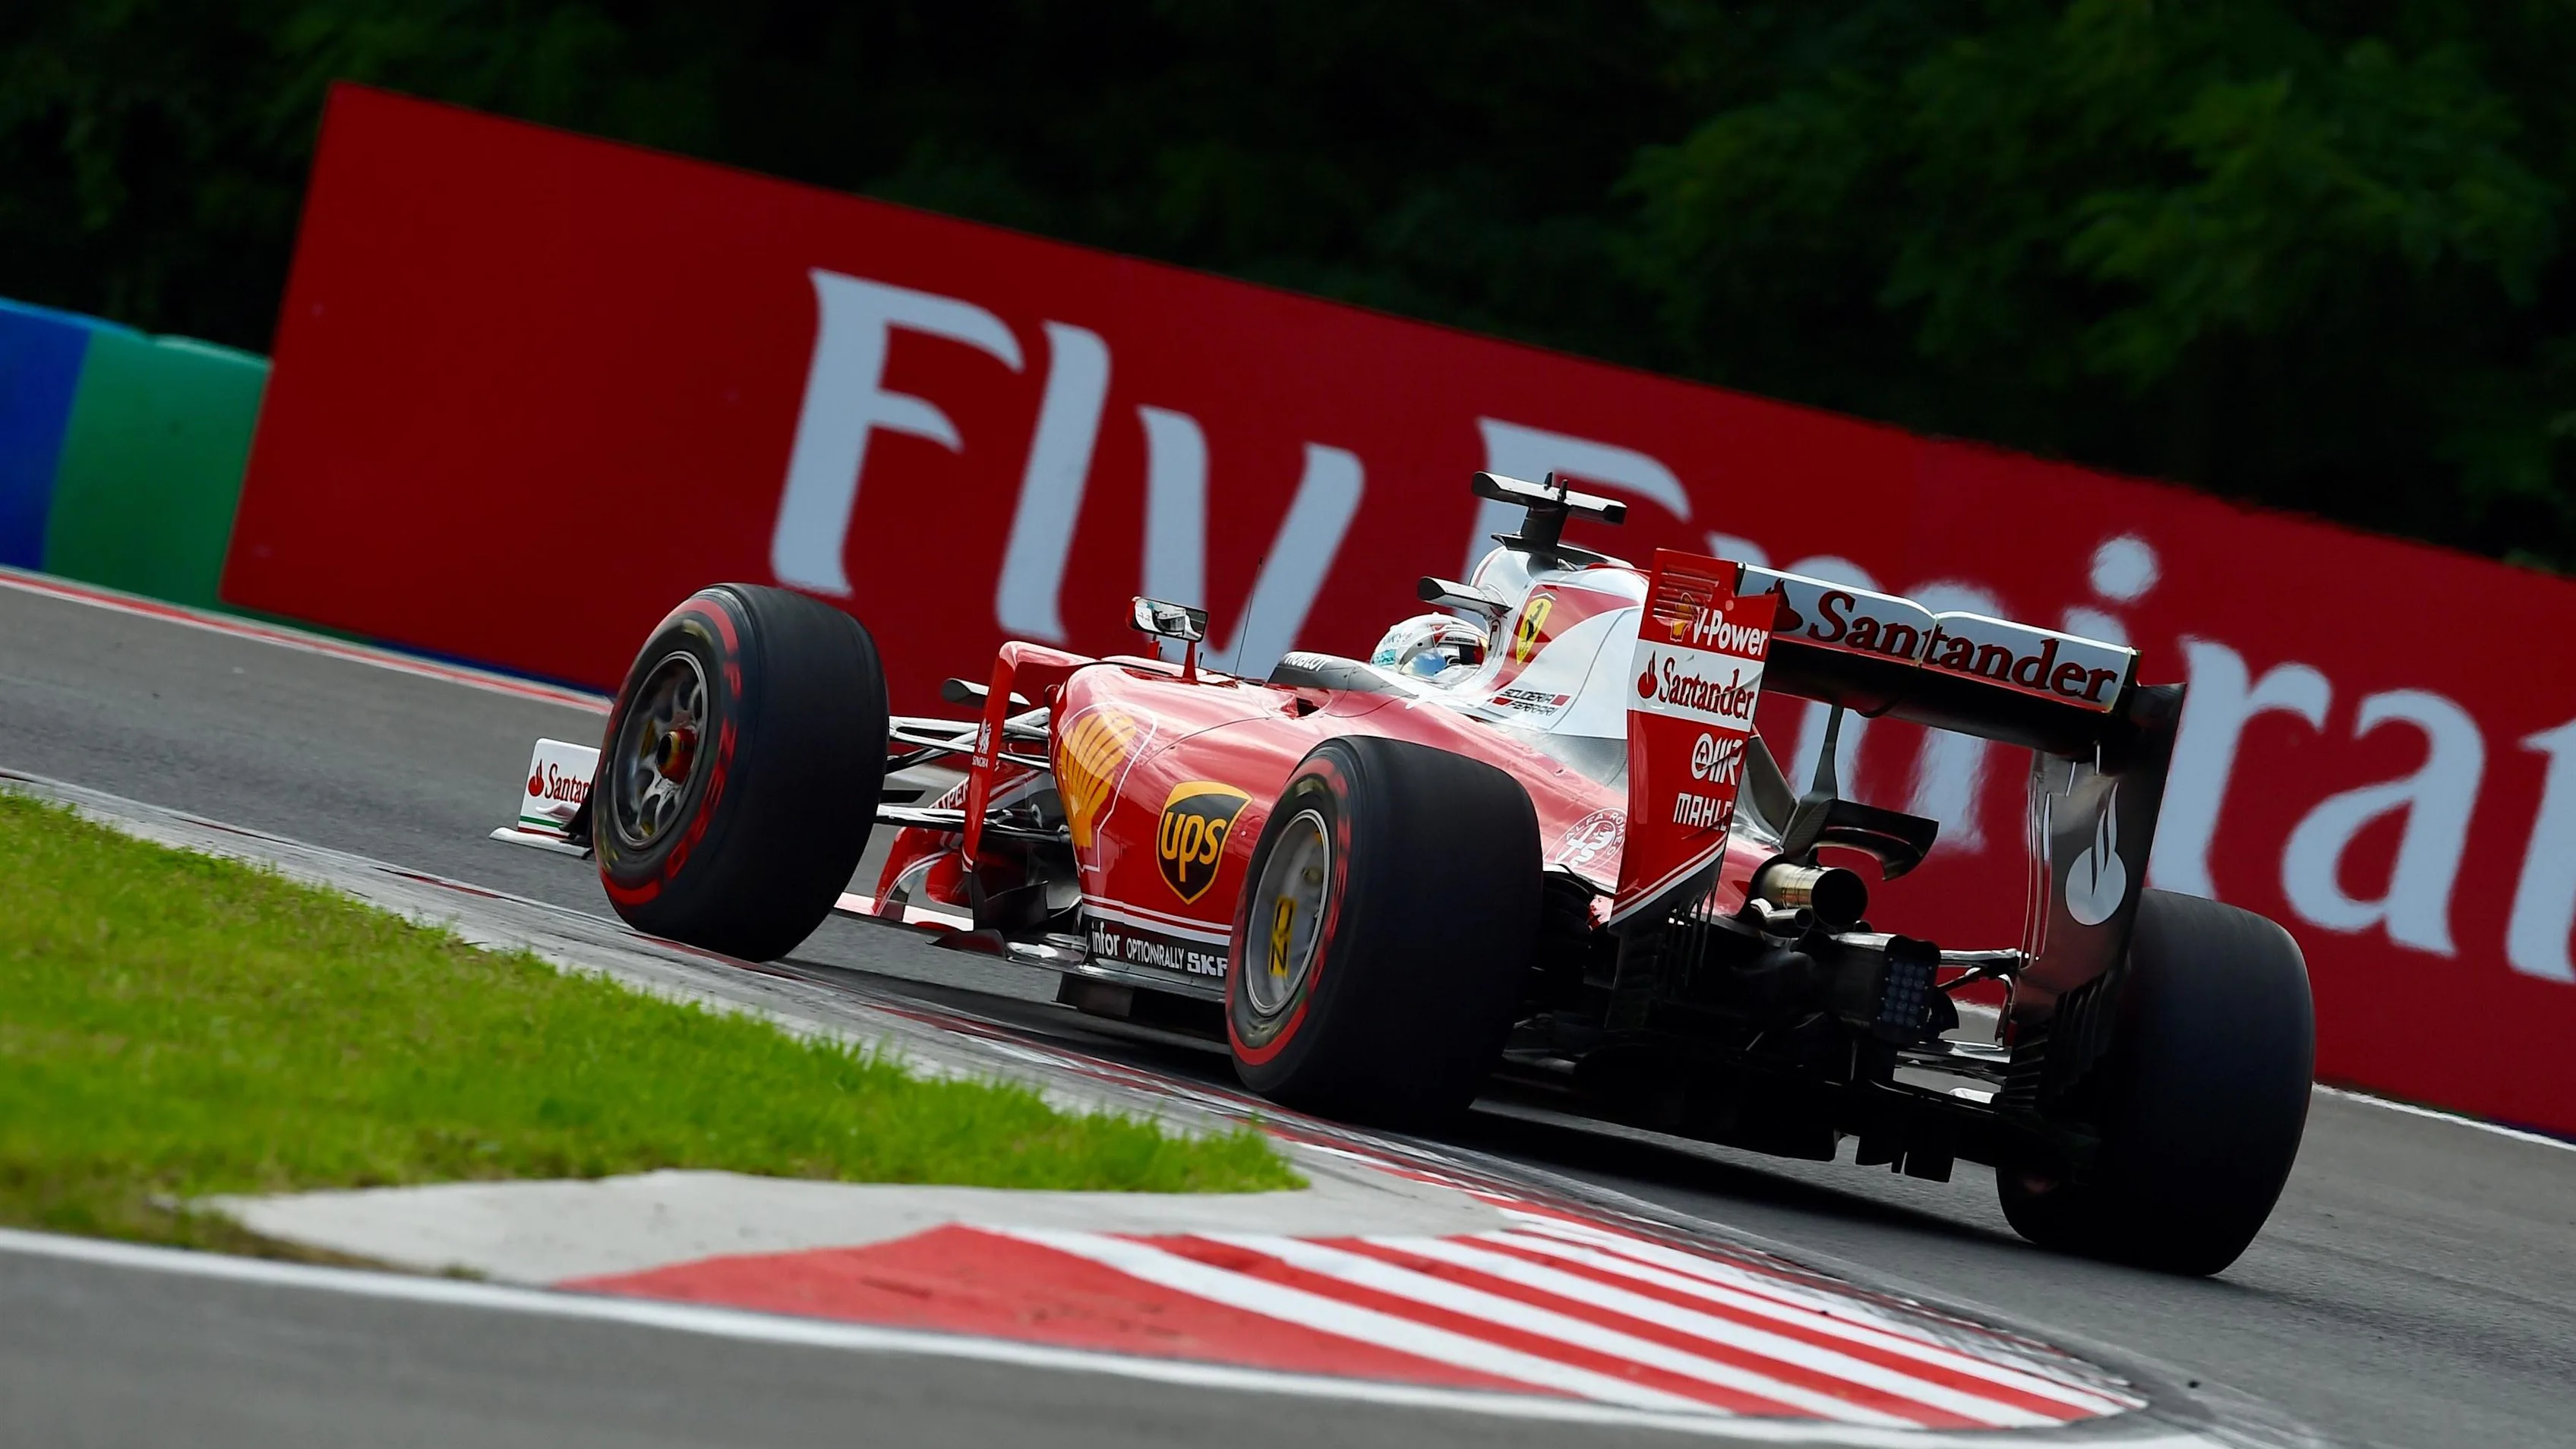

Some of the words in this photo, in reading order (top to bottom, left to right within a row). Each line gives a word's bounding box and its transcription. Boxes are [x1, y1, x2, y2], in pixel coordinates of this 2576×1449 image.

[769, 266, 1366, 678] Fly
[1452, 417, 2576, 985] mrat
[1693, 608, 1769, 656] V-Power
[1807, 591, 2117, 702] Santander
[1505, 700, 1558, 716] FERRARI
[1659, 657, 1755, 720] Santander
[1160, 811, 1227, 882] ups
[1567, 813, 1604, 841] ALFA
[1607, 812, 1626, 857] ROMEO
[1091, 921, 1120, 956] infor
[1187, 952, 1228, 977] SKF
